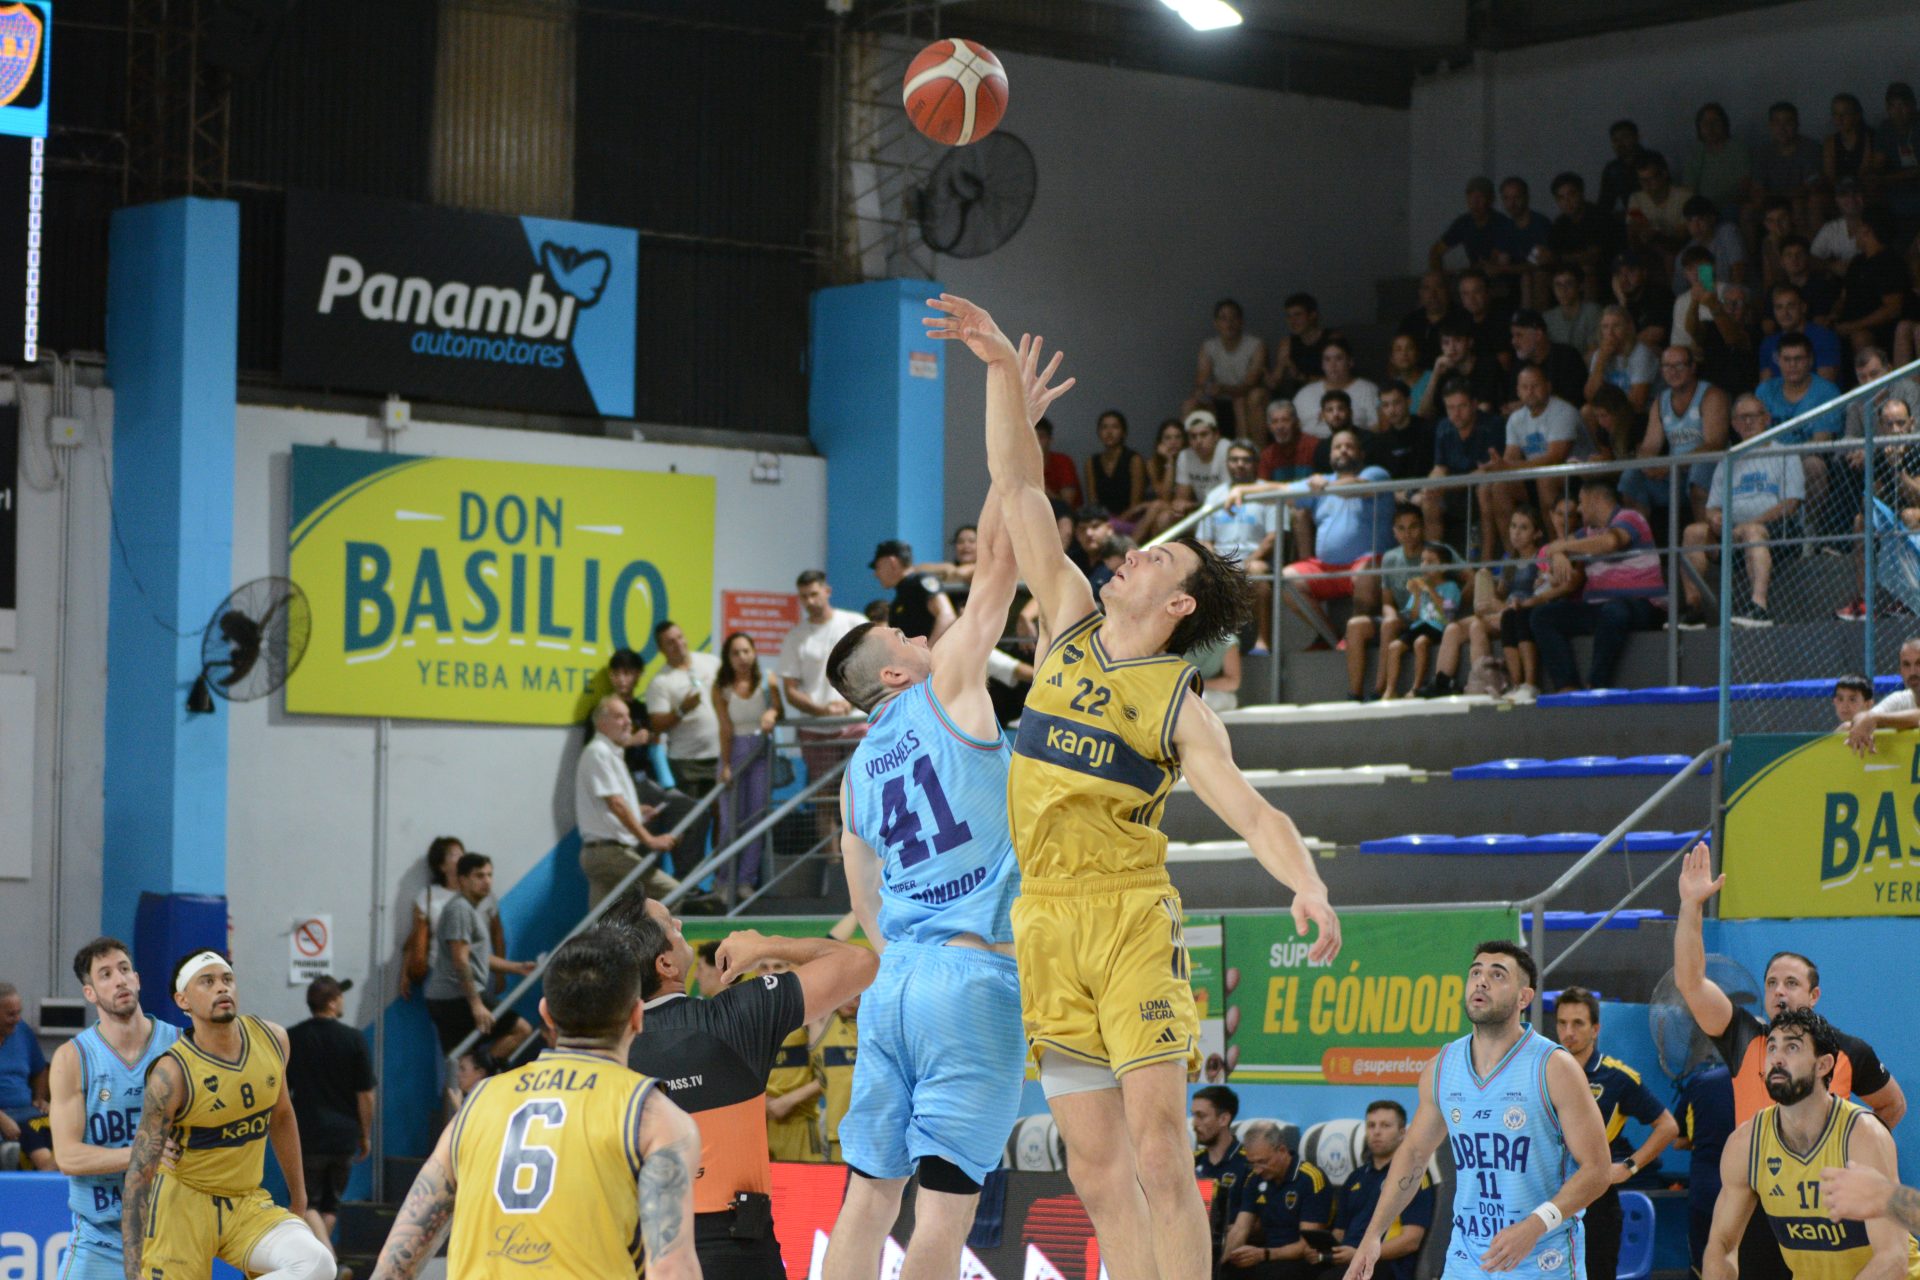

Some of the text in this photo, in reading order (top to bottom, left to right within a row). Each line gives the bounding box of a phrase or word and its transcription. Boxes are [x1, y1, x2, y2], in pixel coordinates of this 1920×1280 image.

[317, 254, 576, 341] Panambi
[410, 330, 566, 368] automotores
[459, 490, 563, 549] DON
[343, 540, 669, 667] BASILIO
[417, 659, 596, 695] YERBA MATE
[1069, 676, 1112, 718] 22
[865, 728, 921, 780] VORHEES
[1046, 724, 1116, 769] kanji
[878, 752, 974, 870] 41
[1139, 999, 1172, 1012] LOMA
[1141, 1009, 1176, 1021] NEGRA
[1262, 959, 1465, 1036] EL CÓNDOR
[239, 1082, 256, 1110] 8
[513, 1068, 599, 1093] SCALA
[493, 1097, 568, 1214] 6
[1475, 1170, 1503, 1201] 11
[1796, 1180, 1820, 1210] 17
[1478, 1200, 1505, 1218] DON
[486, 1222, 553, 1264] Leiva
[1785, 1222, 1848, 1246] kanji
